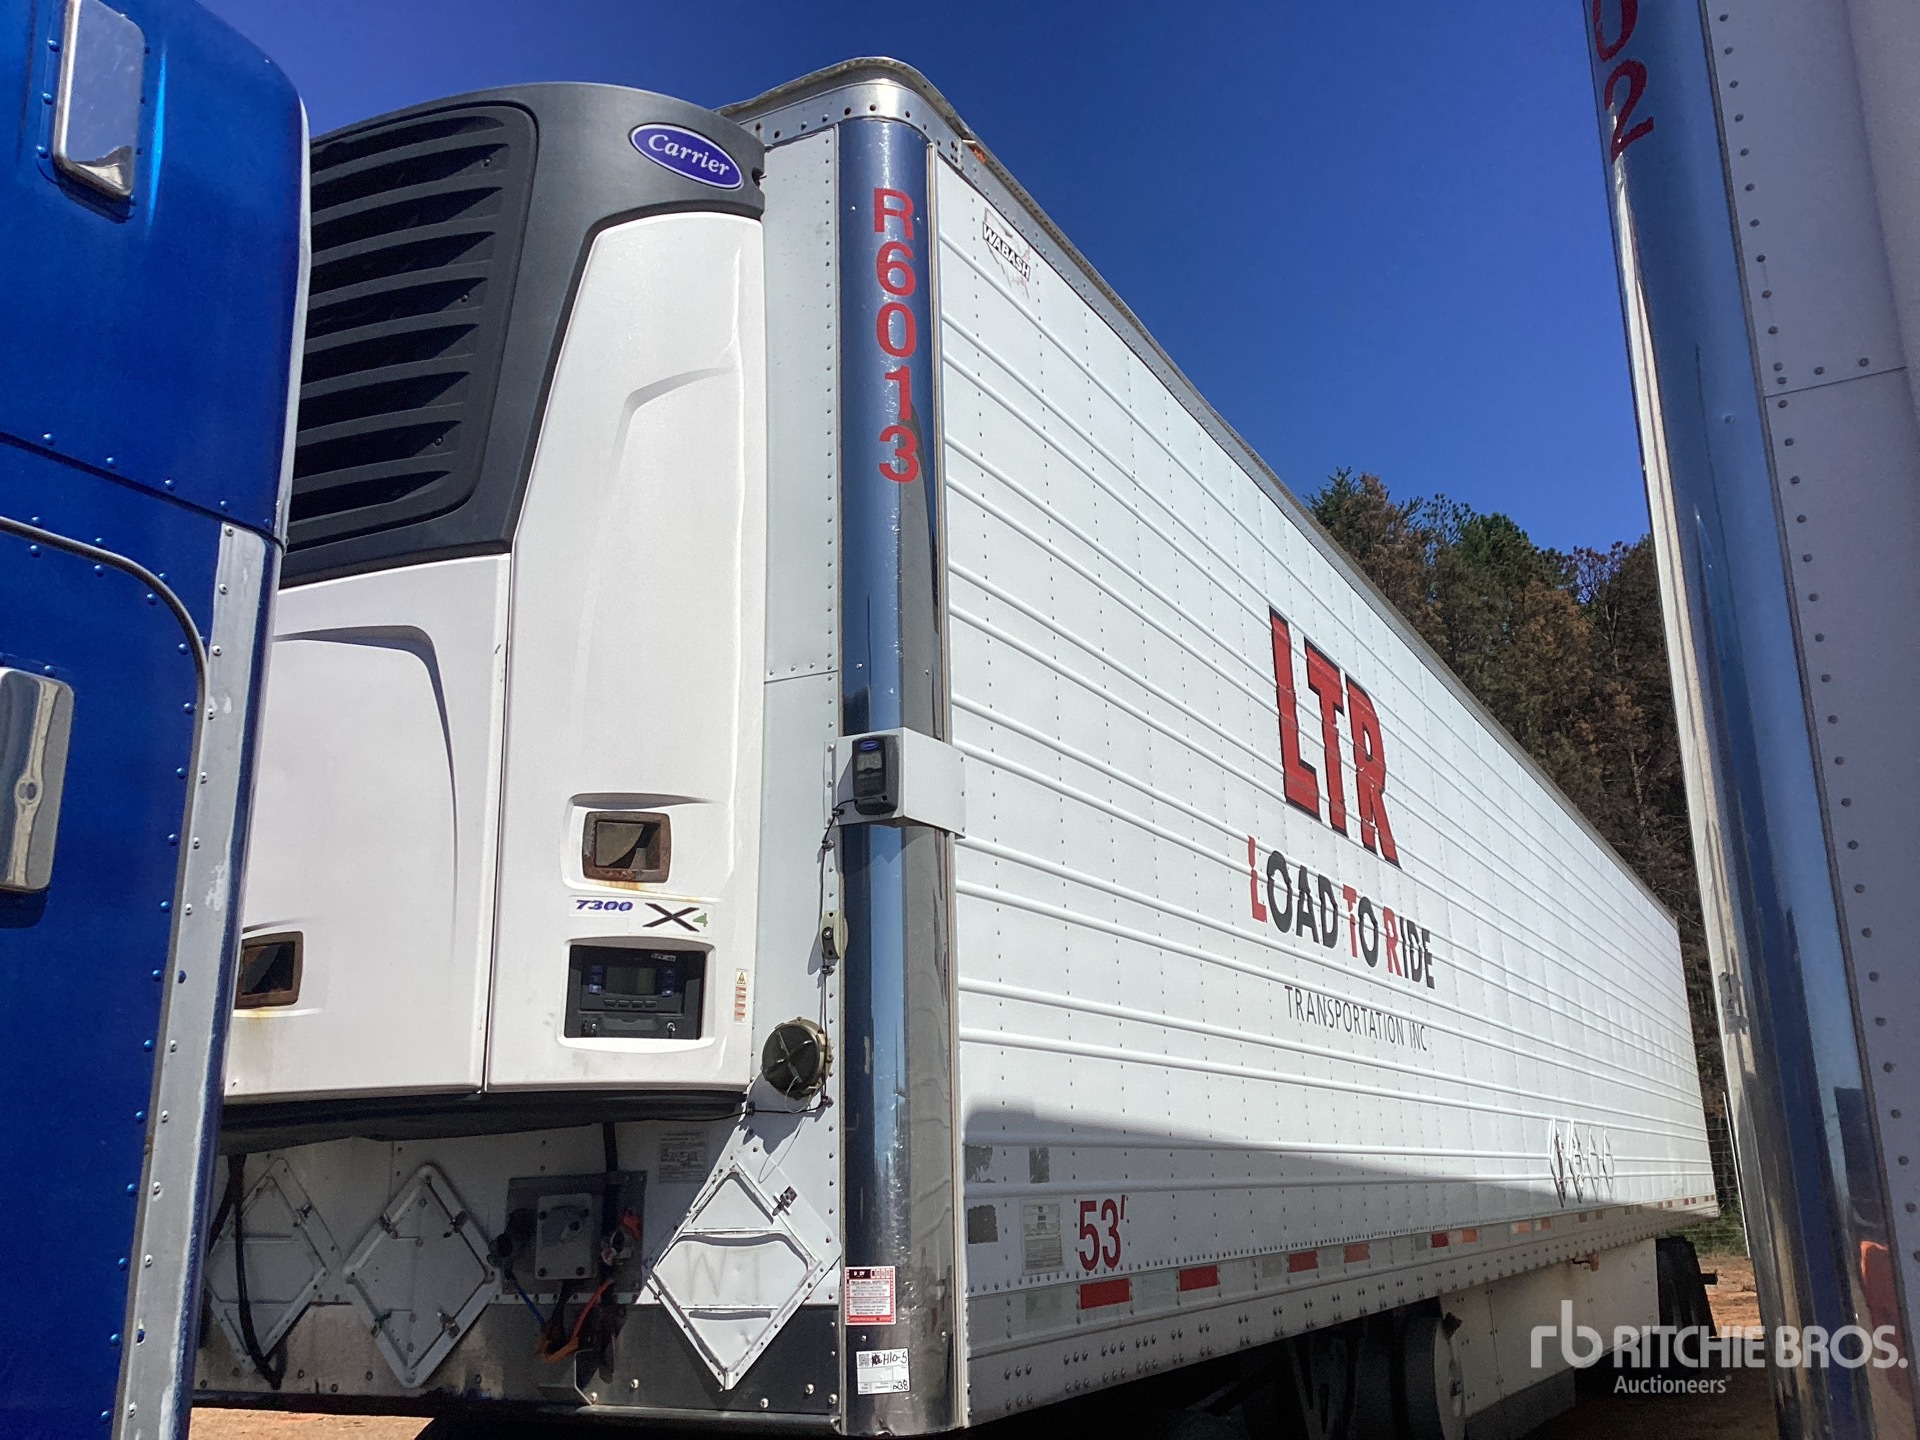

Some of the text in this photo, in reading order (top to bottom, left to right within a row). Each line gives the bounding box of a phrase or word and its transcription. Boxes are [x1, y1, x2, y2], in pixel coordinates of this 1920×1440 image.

[648, 134, 730, 176] Carrier
[983, 222, 1030, 280] WABASH
[873, 188, 919, 483] R6013
[1269, 605, 1402, 870] LTR
[576, 899, 633, 912] 7300
[1248, 835, 1435, 989] LOAD TO RIDE
[1285, 985, 1427, 1051] TRANSPORTATION INC
